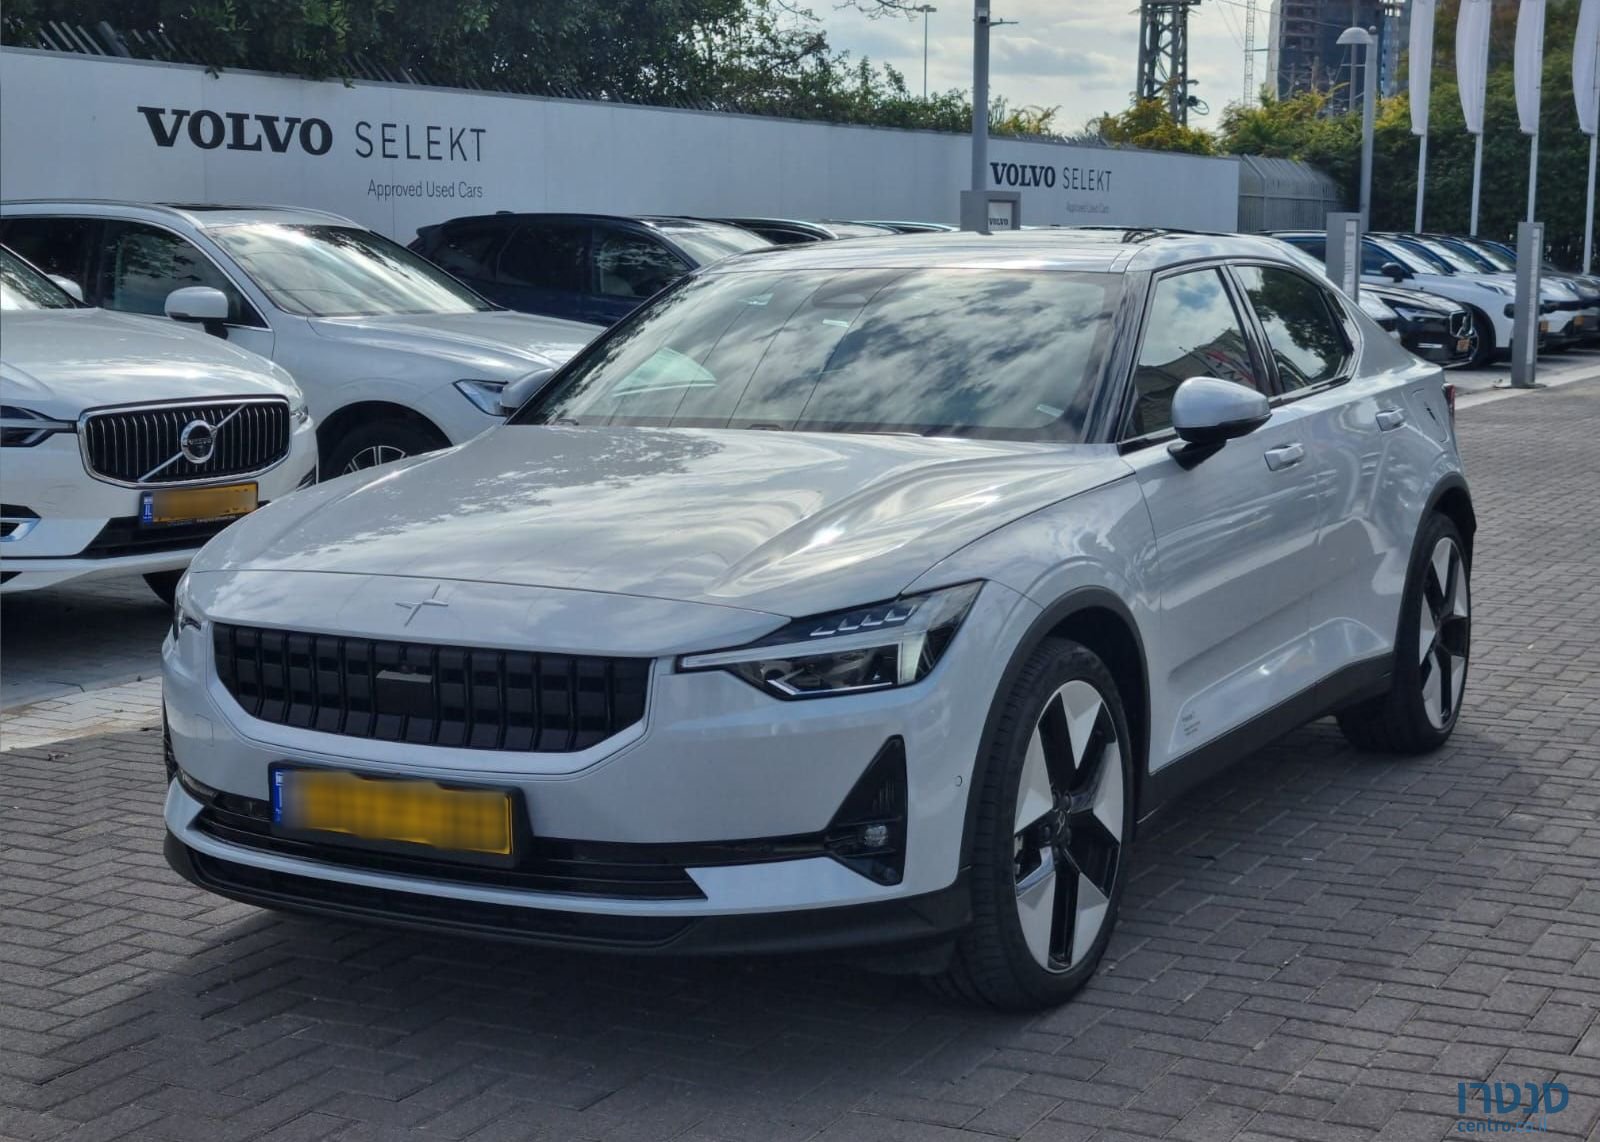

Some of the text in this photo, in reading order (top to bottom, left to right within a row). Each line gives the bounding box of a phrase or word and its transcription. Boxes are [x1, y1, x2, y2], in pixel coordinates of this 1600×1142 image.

[137, 105, 486, 162] VOLVO SELEKT
[990, 162, 1112, 192] VOLVO SELEKT
[367, 179, 483, 202] Approved Used Cars
[989, 217, 1009, 226] VOLVO
